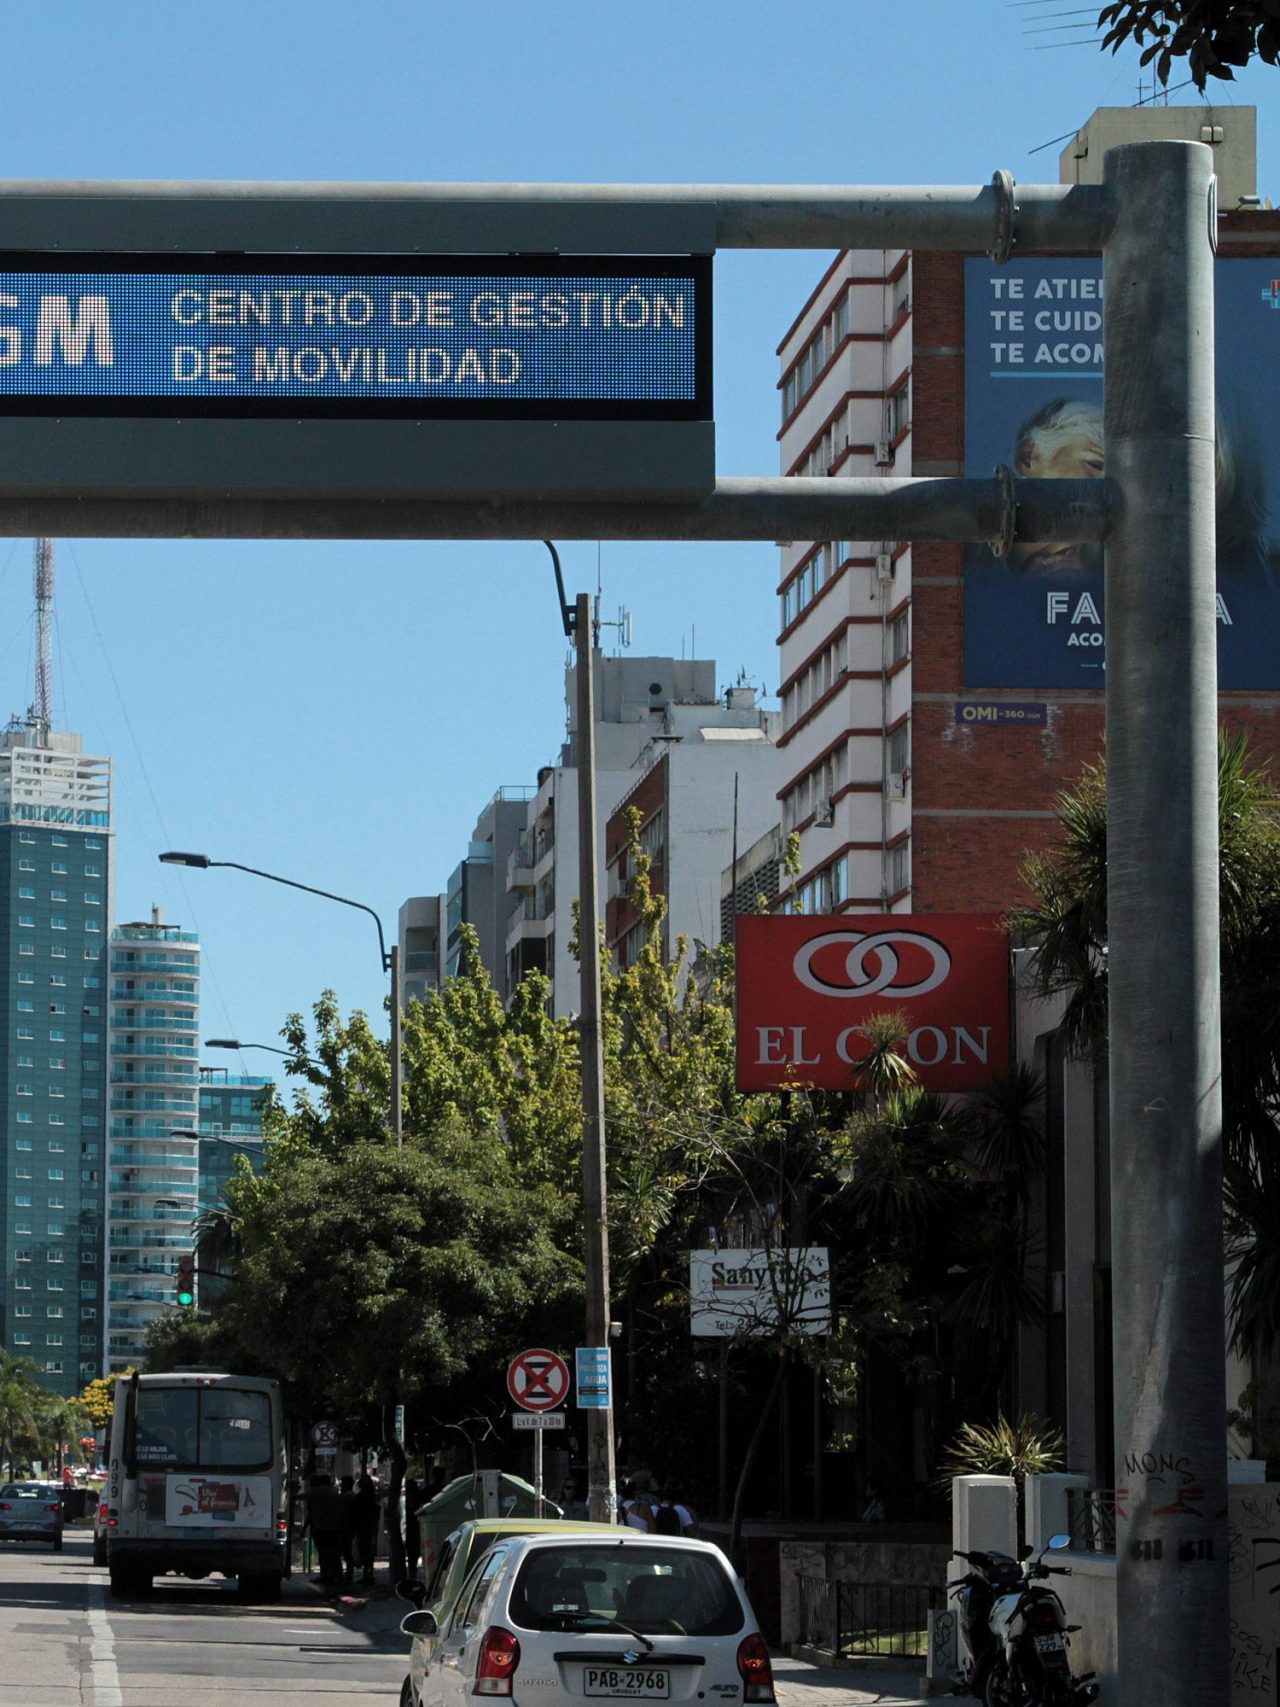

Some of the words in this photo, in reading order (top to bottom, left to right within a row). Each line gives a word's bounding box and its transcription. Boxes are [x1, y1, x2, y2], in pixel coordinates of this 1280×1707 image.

[990, 279, 1024, 299] TE
[1034, 279, 1104, 299] ATIE
[171, 289, 373, 326] CENTRO
[390, 291, 454, 326] DE
[470, 284, 685, 328] GESTIÓN
[990, 311, 1024, 331] TE
[1034, 311, 1103, 331] CUID
[990, 343, 1024, 363] TE
[171, 346, 236, 382] DE
[253, 346, 521, 383] MOVILIDAD
[754, 1026, 821, 1065] EL
[588, 1670, 618, 1689] PAB
[626, 1672, 665, 1690] 2968
